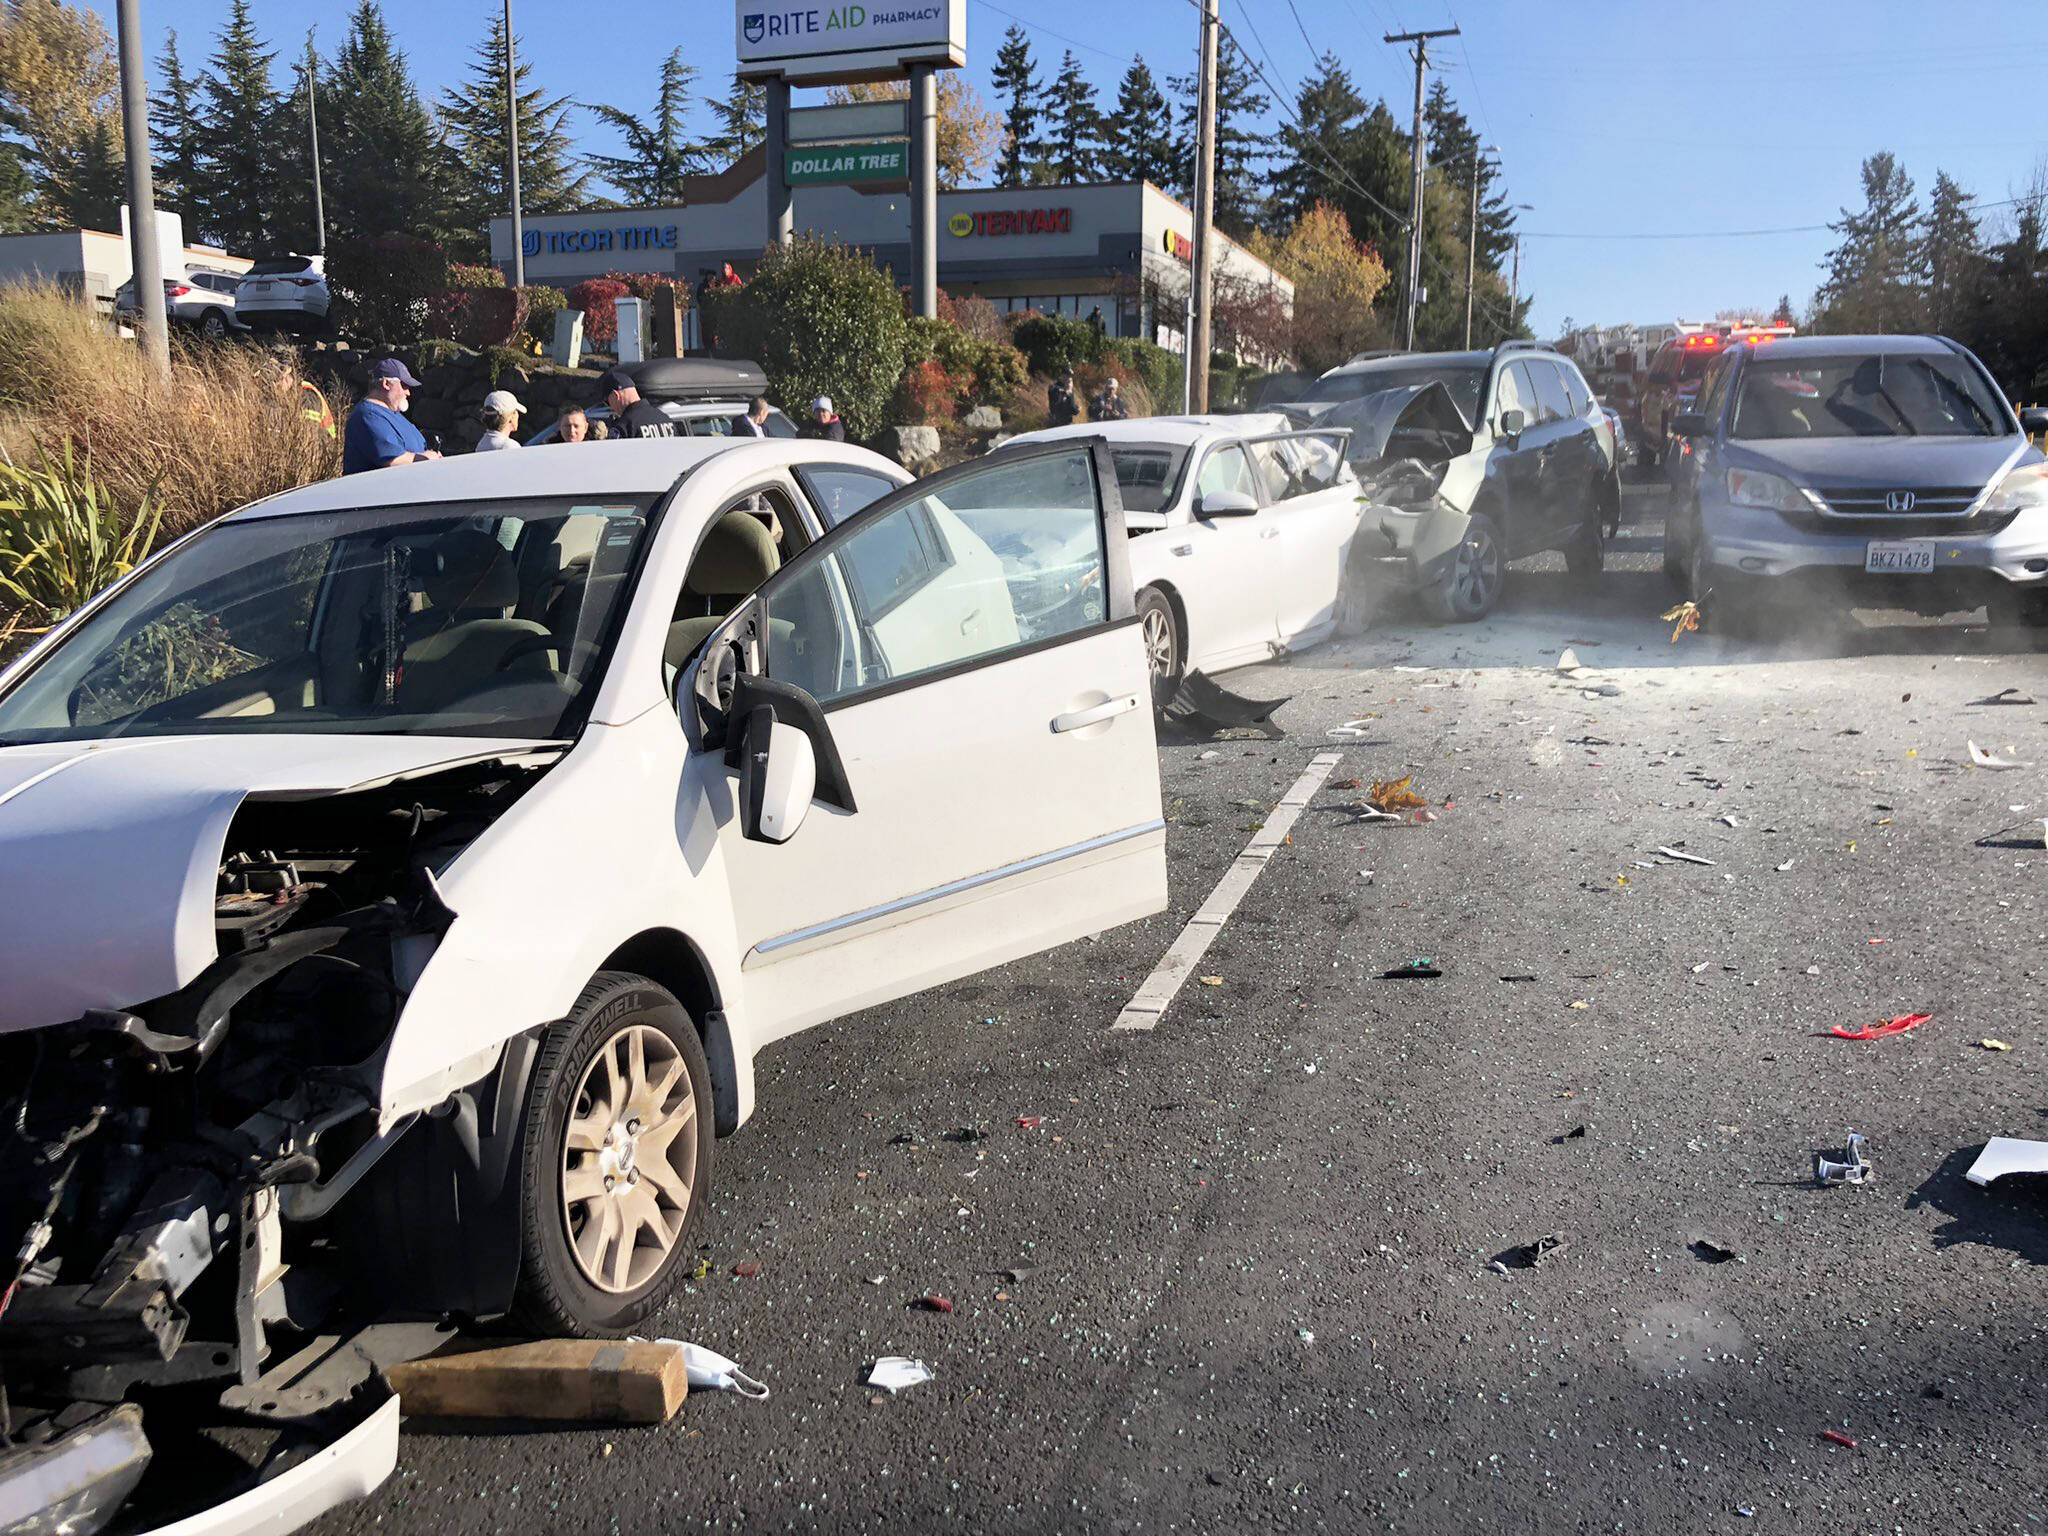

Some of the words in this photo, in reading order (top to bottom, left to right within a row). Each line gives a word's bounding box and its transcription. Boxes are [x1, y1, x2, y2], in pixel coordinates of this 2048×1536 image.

[769, 10, 819, 37] RITE
[826, 6, 866, 31] AID
[873, 7, 941, 25] PHARMACY
[792, 156, 855, 174] DOLLAR
[859, 154, 900, 170] TREE
[973, 207, 1071, 236] TERIYAKI
[545, 229, 612, 253] TICOR
[618, 225, 677, 250] TITLE
[1870, 552, 1930, 568] BKZ1478
[557, 993, 642, 1105] PRIMEWELL
